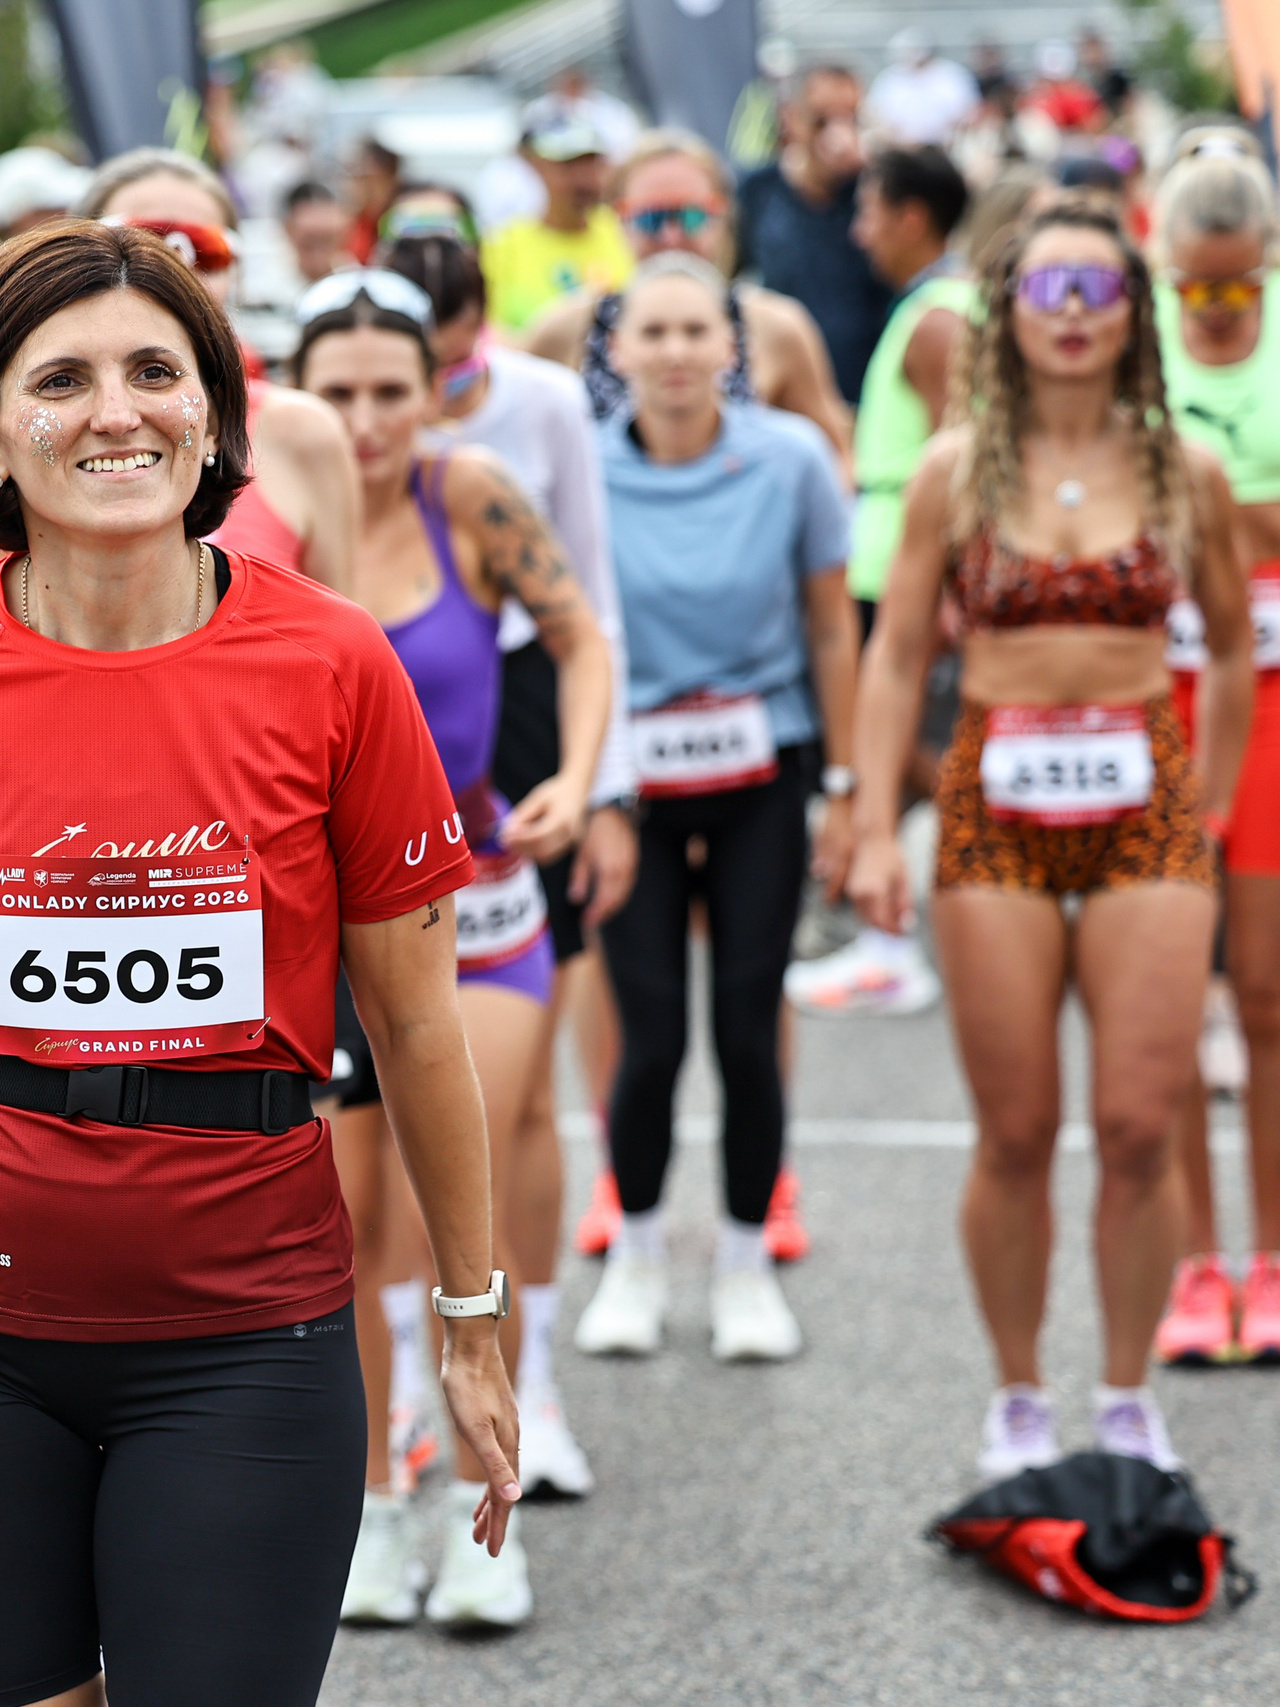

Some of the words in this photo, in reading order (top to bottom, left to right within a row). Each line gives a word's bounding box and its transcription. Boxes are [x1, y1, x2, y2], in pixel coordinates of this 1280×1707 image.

[7, 868, 25, 878] LADY
[106, 872, 137, 880] Legenda
[148, 869, 173, 879] MIR
[175, 863, 247, 878] SUPREME
[95, 893, 186, 910] СИРИУС
[193, 889, 249, 907] 2026
[10, 946, 224, 1004] 6505
[79, 1041, 143, 1052] GRAND
[149, 1037, 205, 1051] FINAL
